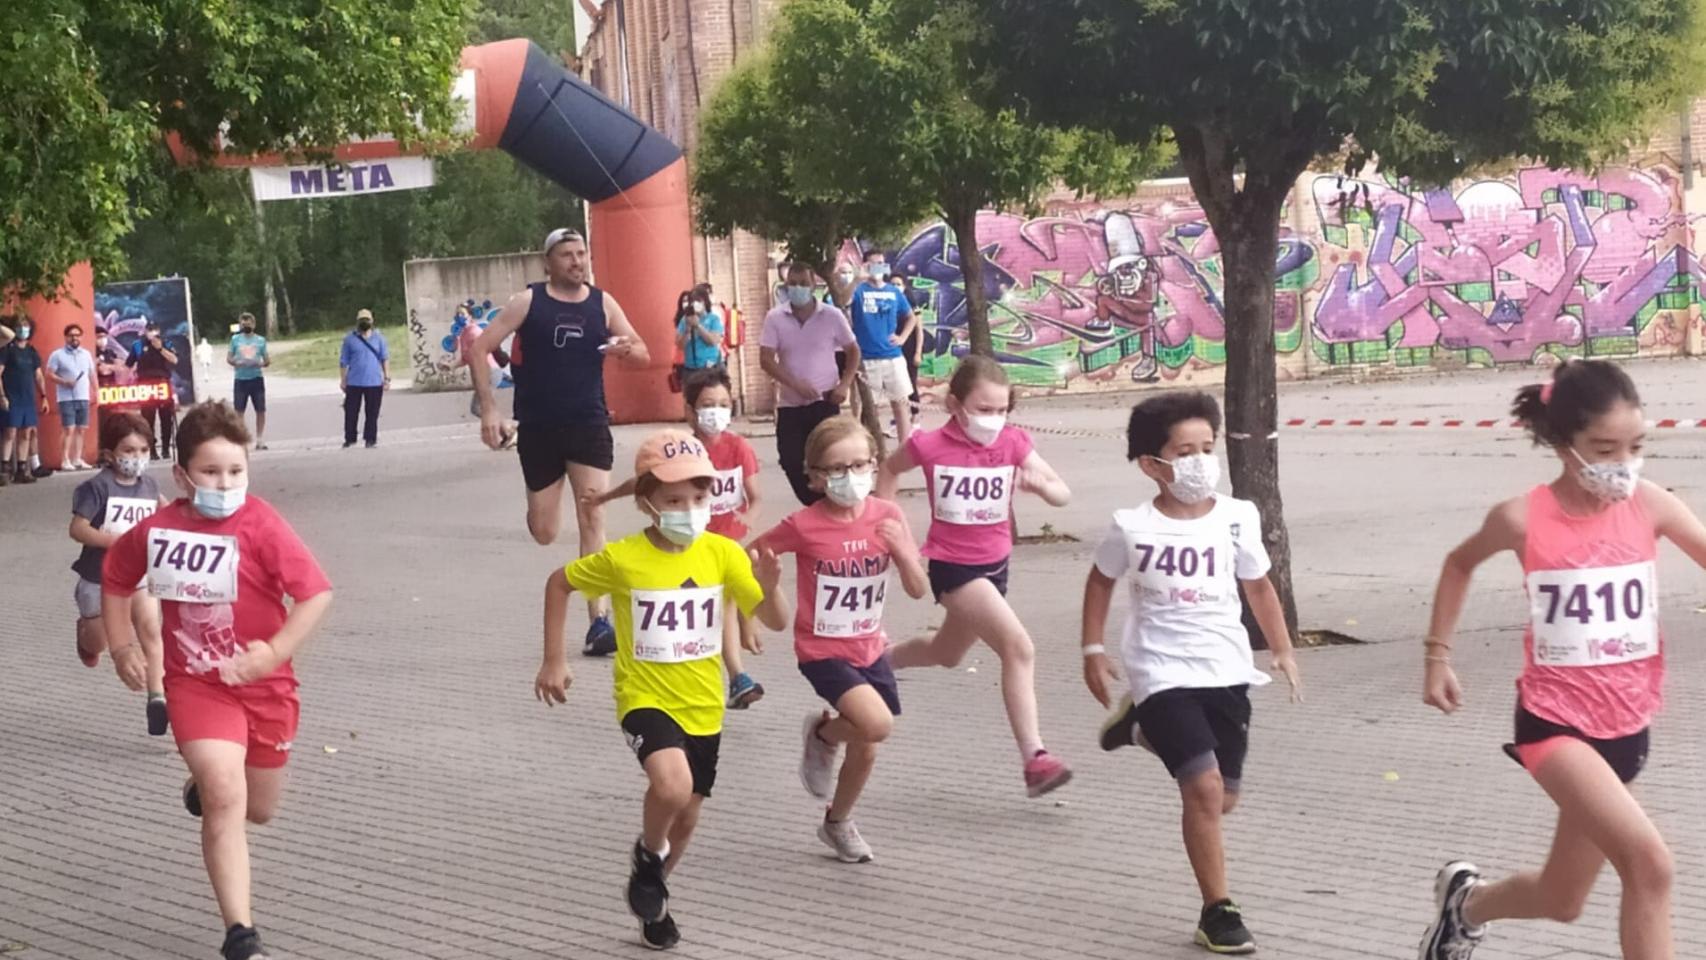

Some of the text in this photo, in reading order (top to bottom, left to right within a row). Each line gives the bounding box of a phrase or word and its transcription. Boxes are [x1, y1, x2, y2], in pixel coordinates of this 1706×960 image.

[290, 164, 394, 194] META
[940, 475, 1003, 500] 7408
[153, 539, 226, 574] 7407
[1135, 544, 1215, 577] 7401
[823, 580, 885, 611] 7414
[1539, 578, 1643, 624] 7410
[638, 598, 714, 631] 7411
